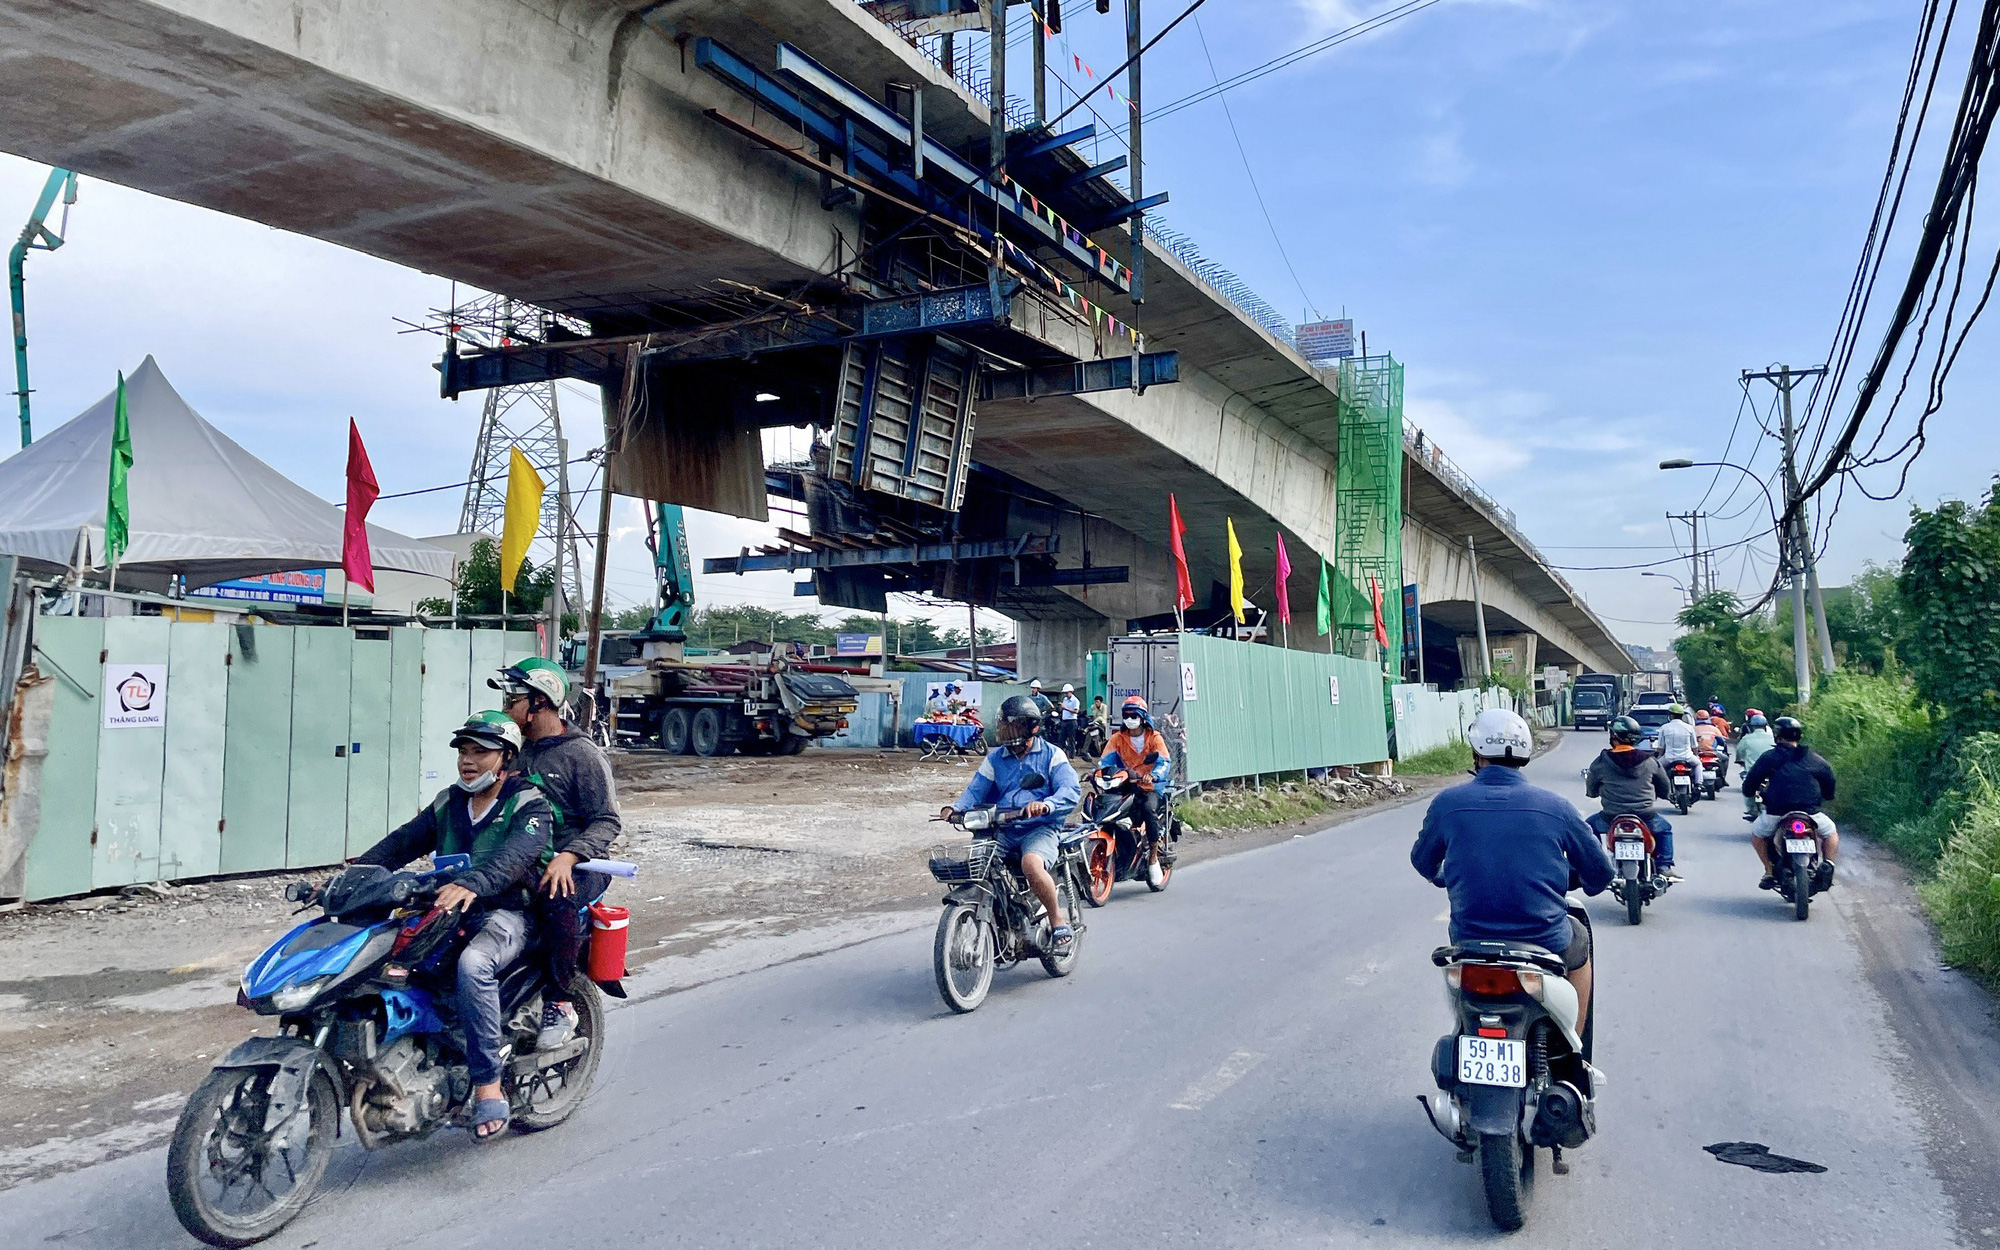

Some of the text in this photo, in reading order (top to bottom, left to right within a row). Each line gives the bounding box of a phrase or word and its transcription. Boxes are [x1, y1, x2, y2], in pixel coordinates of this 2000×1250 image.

[127, 685, 148, 698] TL
[1469, 1039, 1513, 1061] 59-M1
[1463, 1060, 1521, 1083] 528.38
